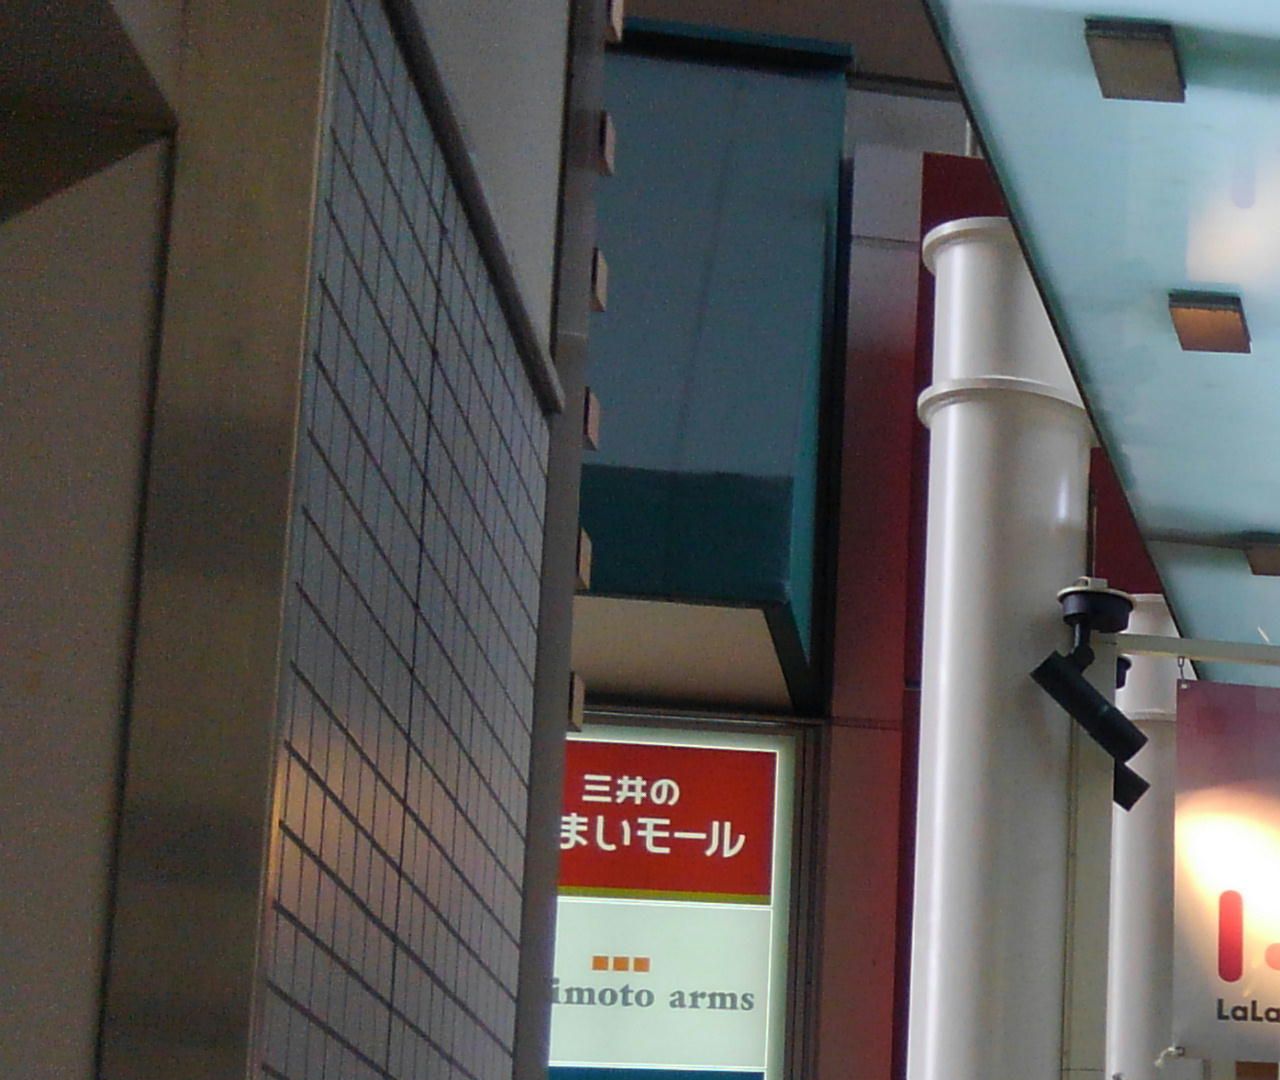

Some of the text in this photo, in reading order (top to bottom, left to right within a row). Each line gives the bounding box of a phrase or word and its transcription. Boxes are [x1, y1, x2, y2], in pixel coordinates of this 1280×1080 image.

[582, 773, 681, 806] 三井の
[669, 988, 755, 1011] arms
[1216, 998, 1280, 1023] LaLa
